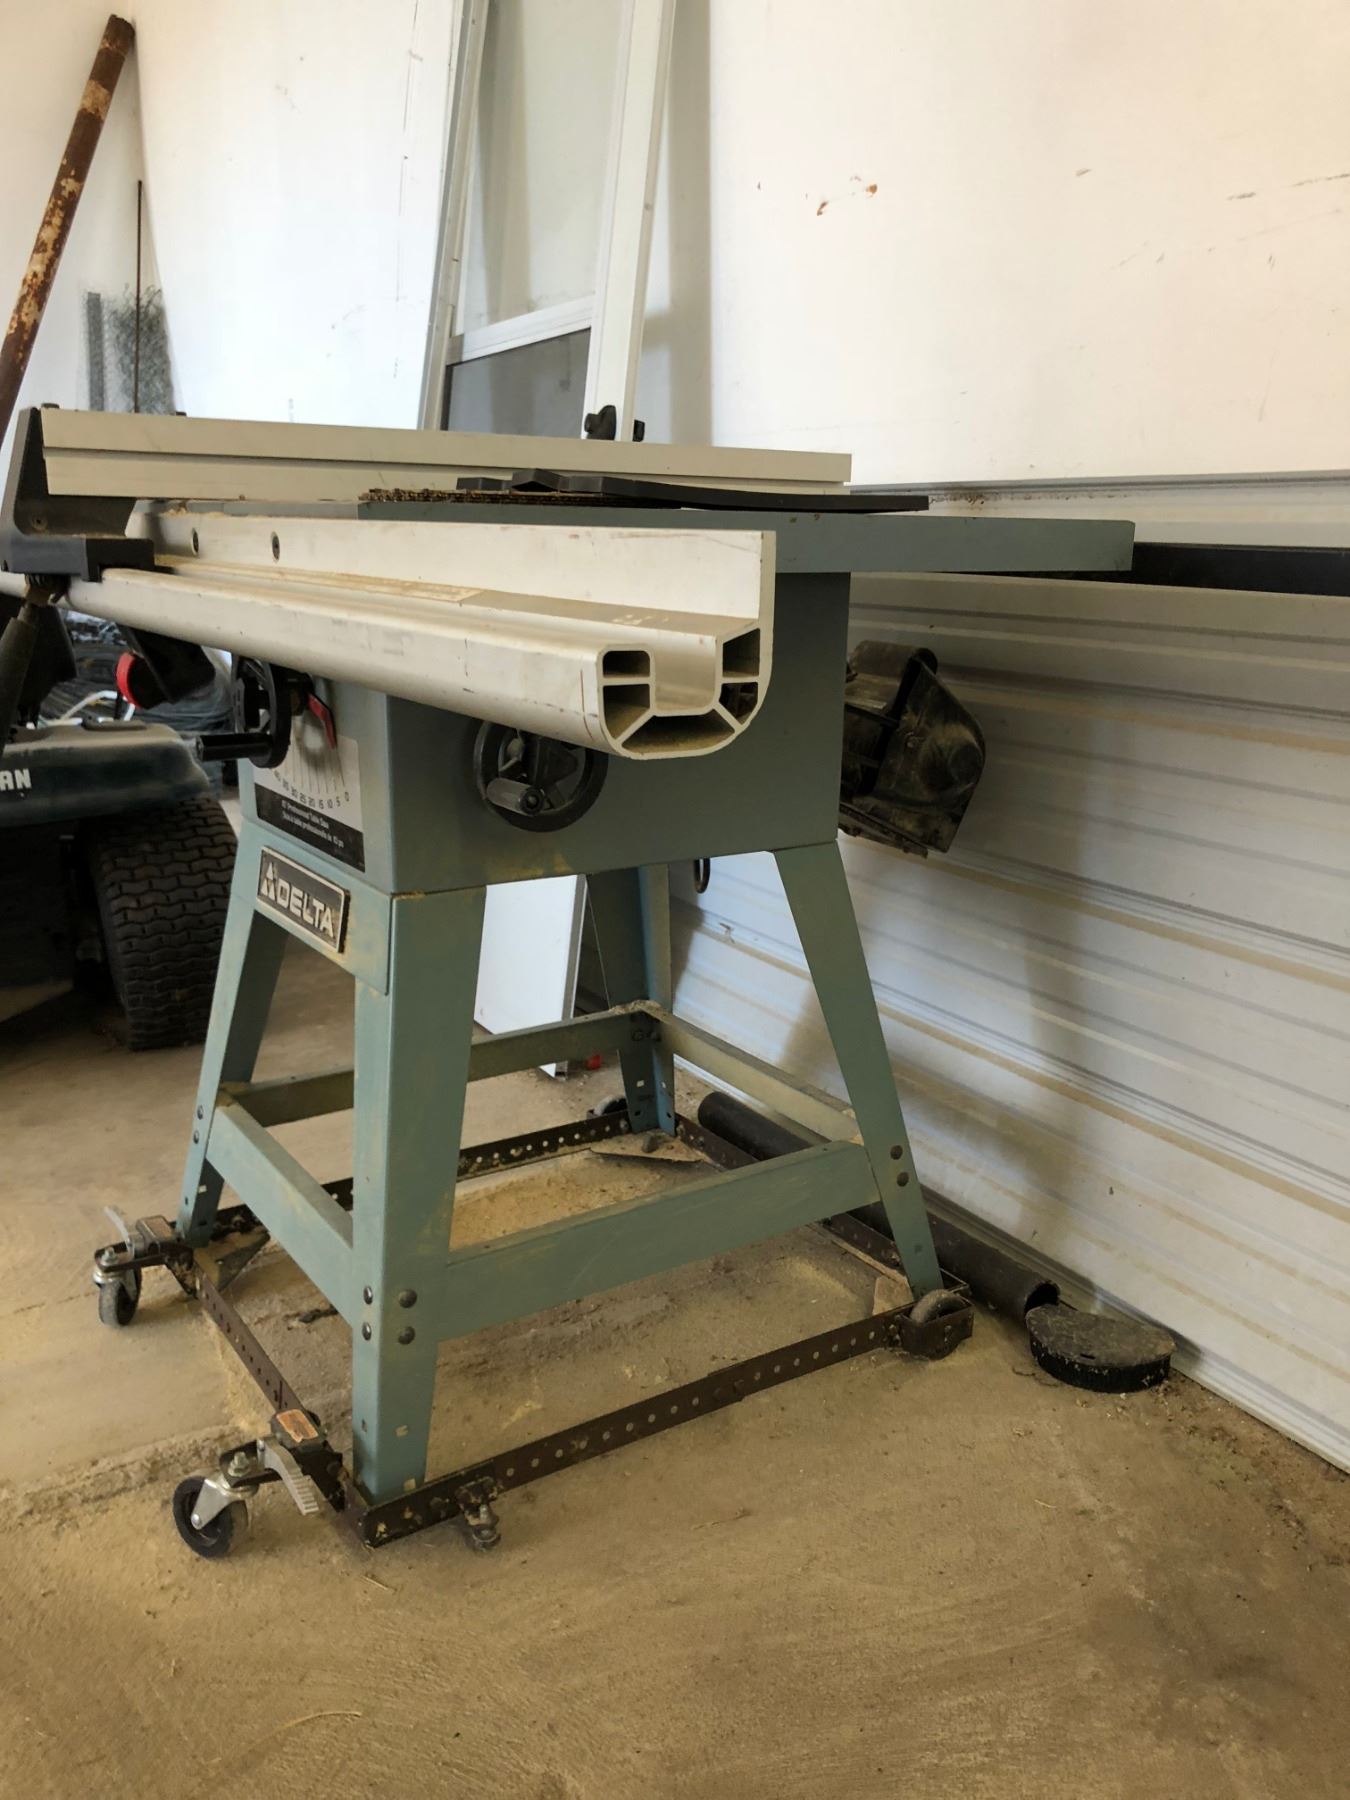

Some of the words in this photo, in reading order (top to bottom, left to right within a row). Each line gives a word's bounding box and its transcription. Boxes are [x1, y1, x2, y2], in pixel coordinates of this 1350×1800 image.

[327, 799, 333, 809] 10
[336, 796, 341, 807] 5
[344, 791, 350, 802] 0
[276, 878, 333, 938] DELTA
